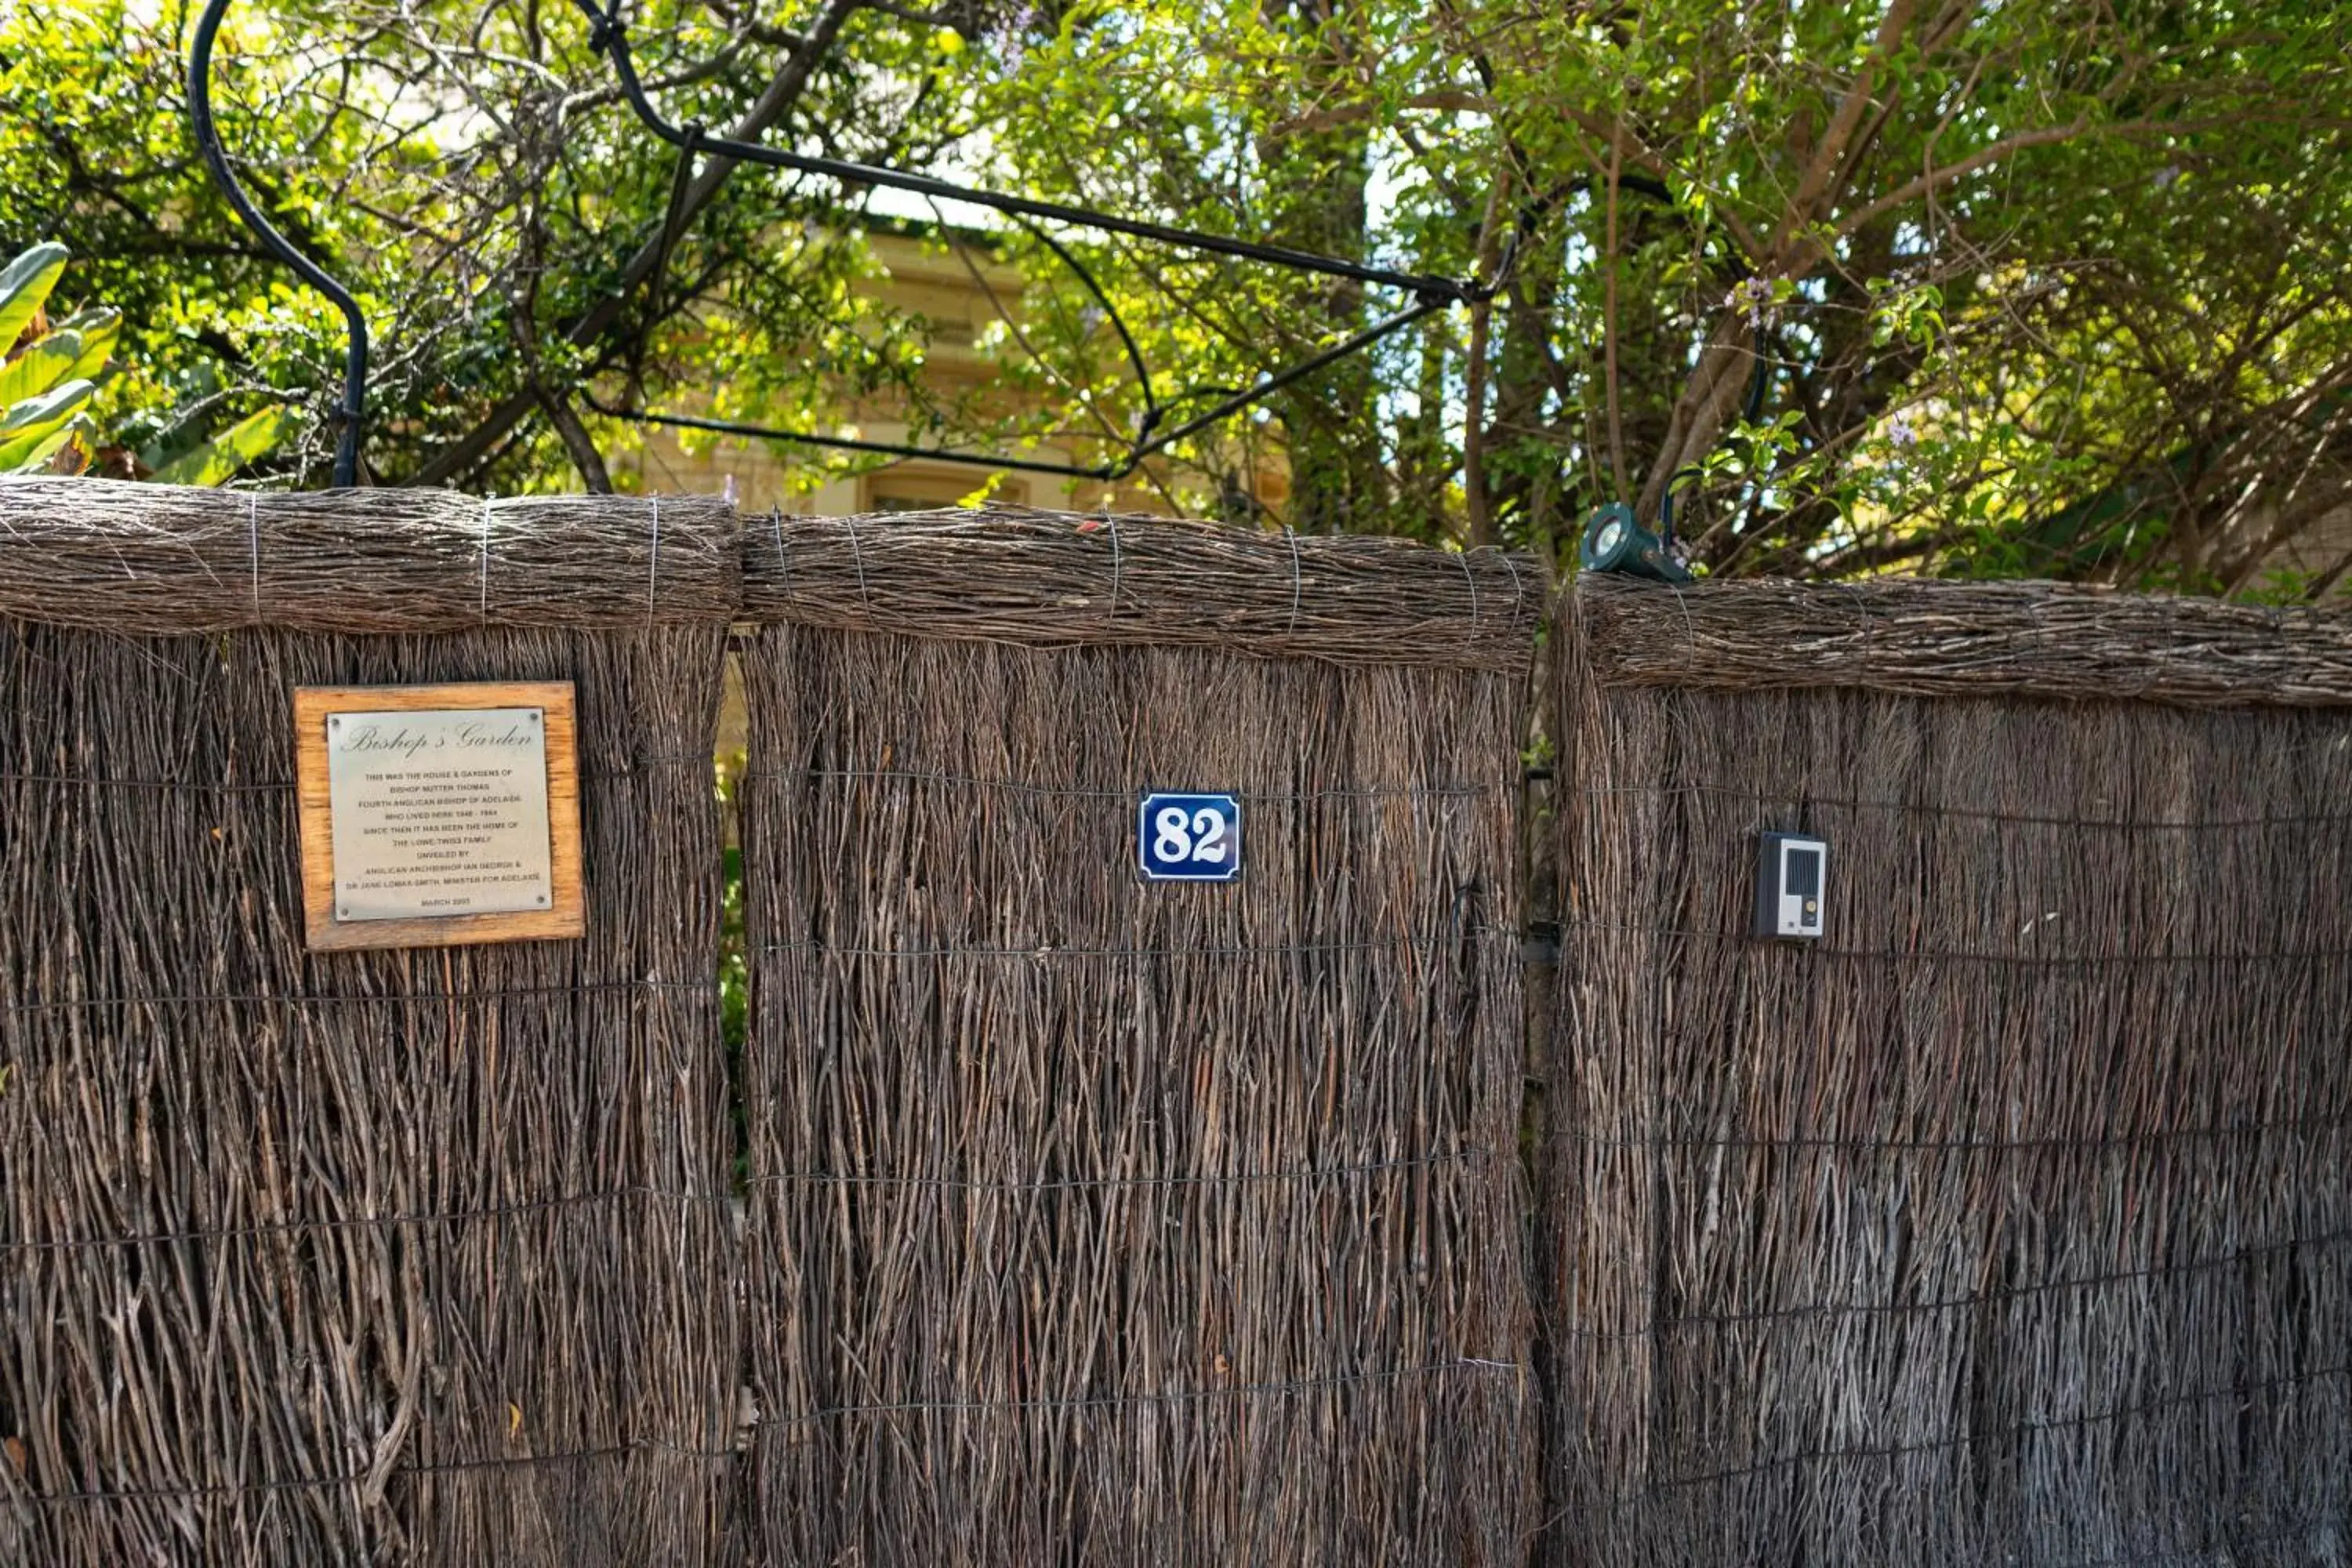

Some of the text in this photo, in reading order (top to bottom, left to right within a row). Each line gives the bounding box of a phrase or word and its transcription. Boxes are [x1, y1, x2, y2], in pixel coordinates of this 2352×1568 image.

[456, 722, 531, 747] Garden
[1154, 807, 1226, 863] 82
[416, 851, 456, 859] UNVEILED
[409, 864, 461, 873] ARCHBISHOP
